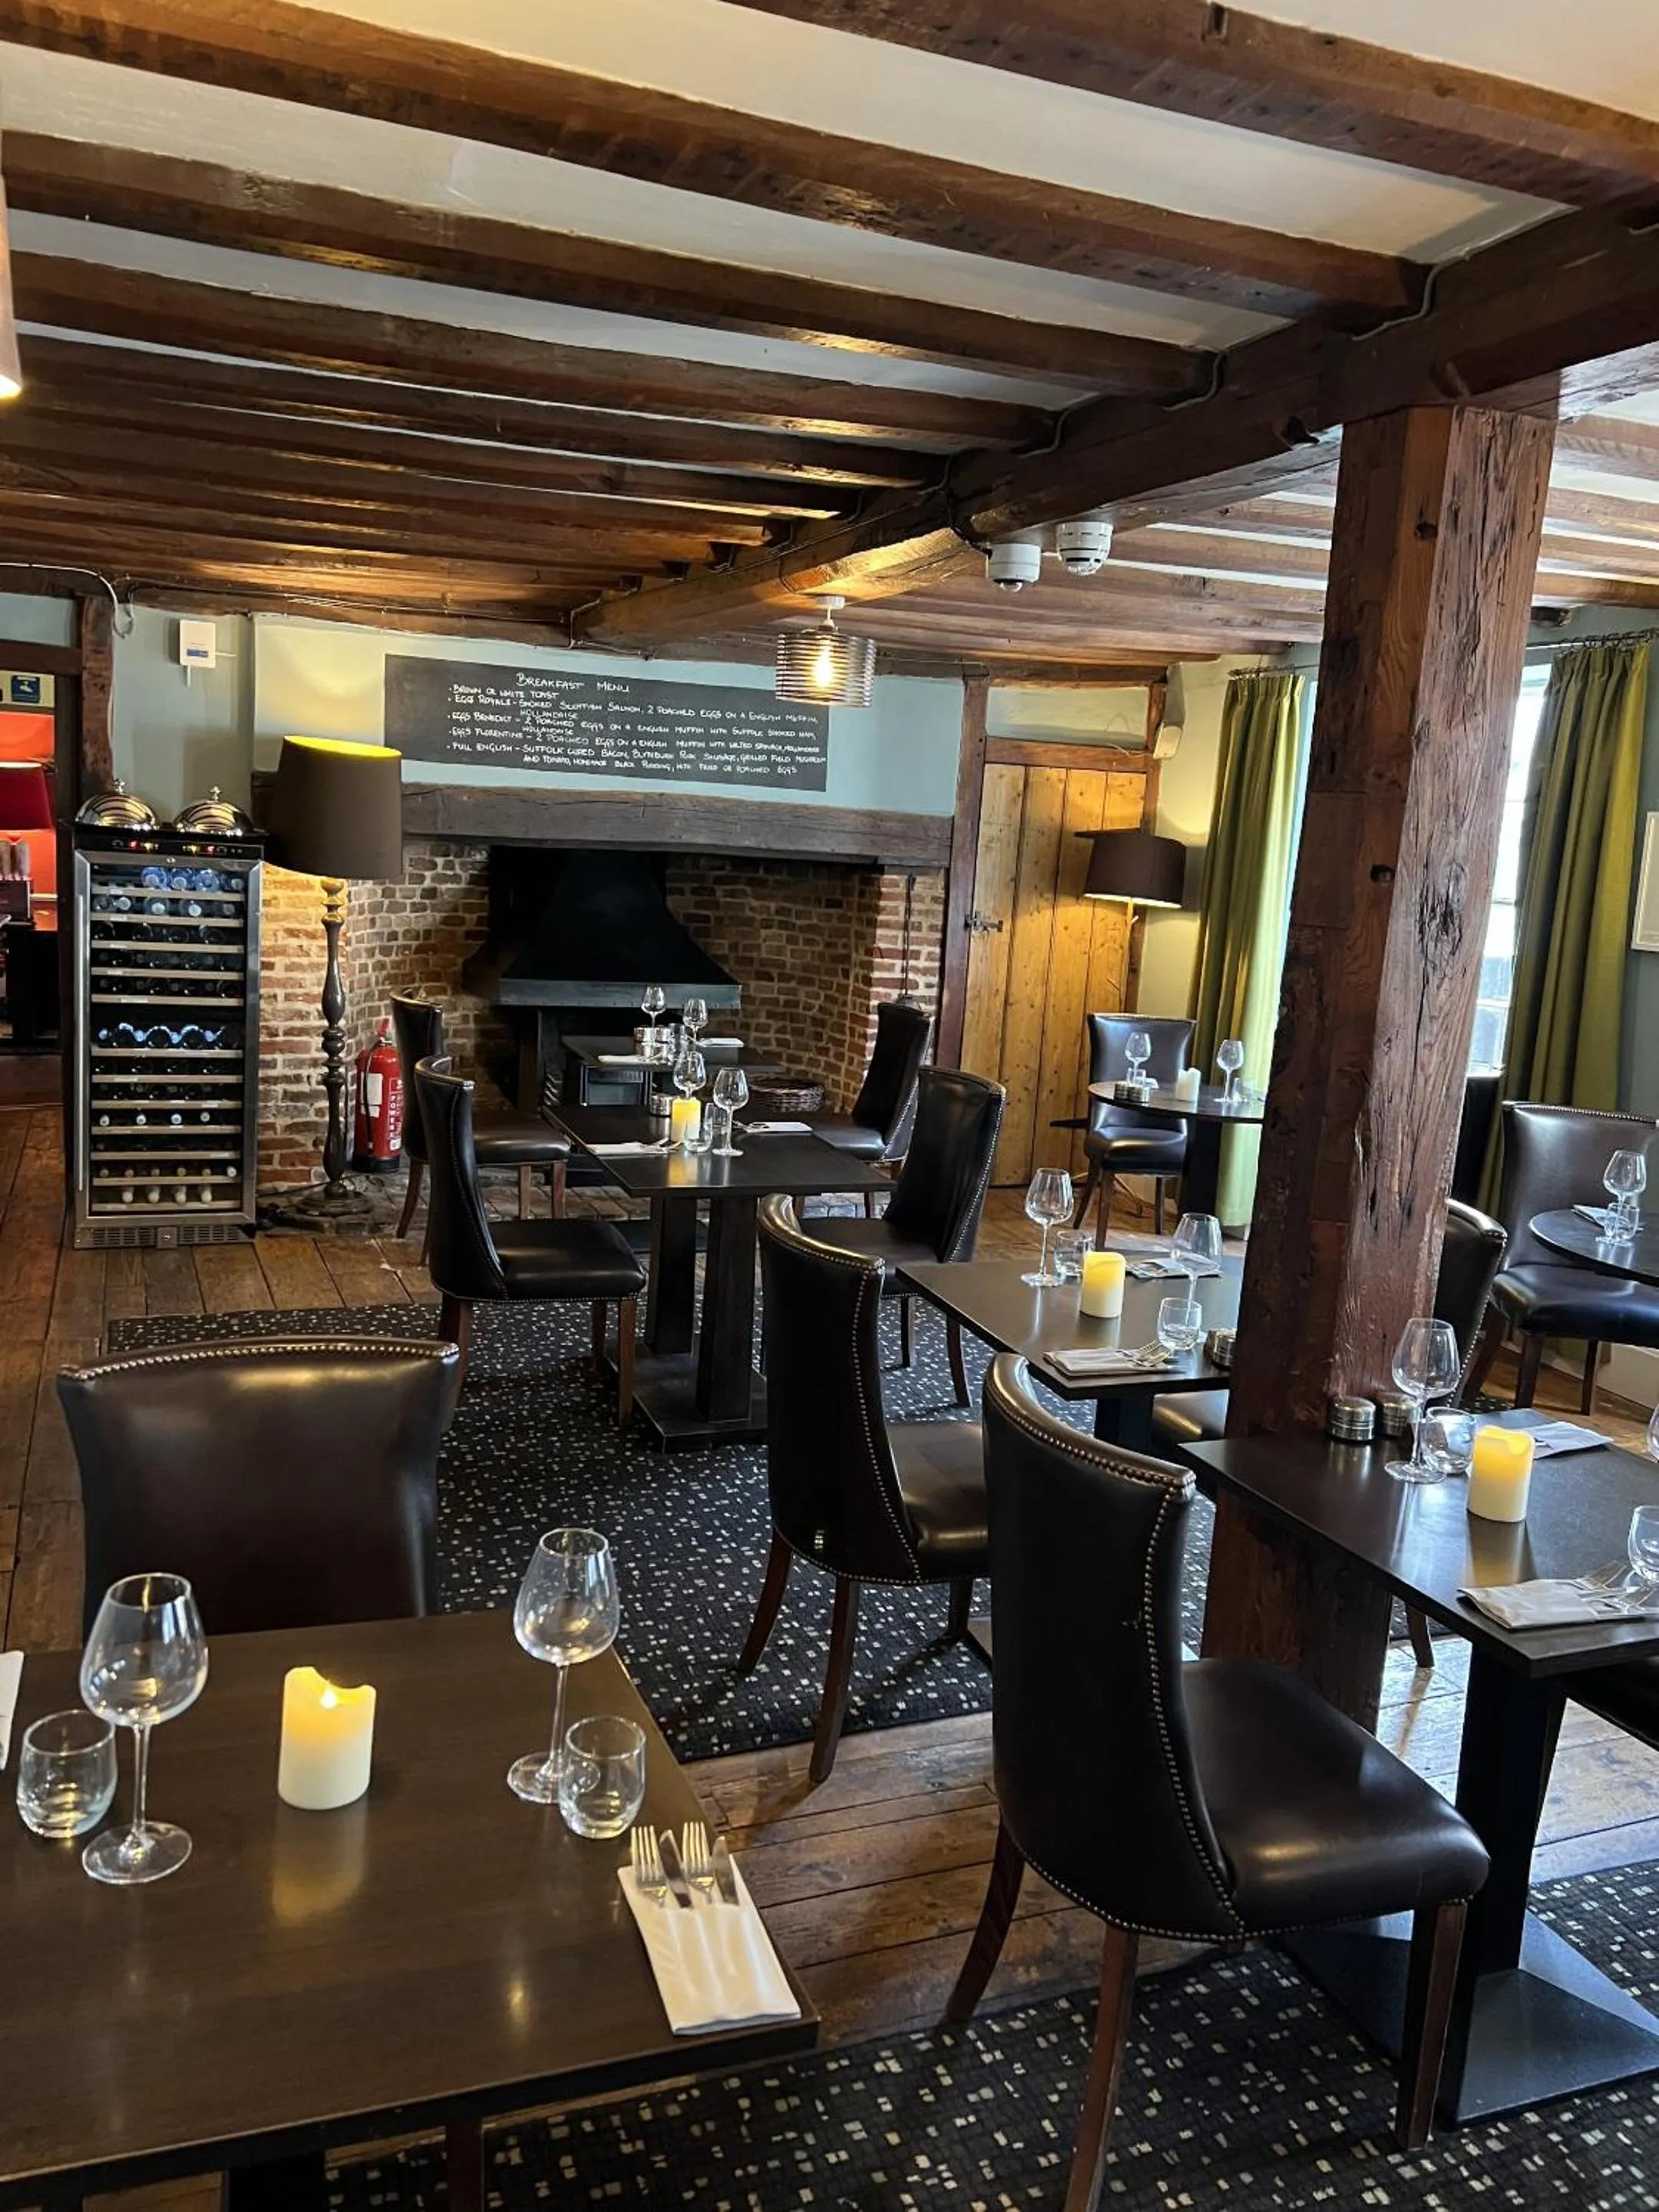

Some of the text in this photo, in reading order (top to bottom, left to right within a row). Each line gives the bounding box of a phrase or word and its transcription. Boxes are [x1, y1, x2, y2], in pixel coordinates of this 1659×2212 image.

[516, 673, 630, 693] BREAKFAST MENU
[453, 684, 481, 694] BROWN
[500, 689, 525, 698] WHITE
[530, 691, 560, 700] TOAST
[478, 694, 511, 706] ROYALE
[519, 699, 552, 708] SMOKED
[559, 700, 602, 710] SCOTTISH
[656, 706, 696, 716] POACHED
[451, 741, 473, 752] FULL
[475, 742, 514, 754] ENGLISH
[522, 743, 565, 754] SUFFOLK
[616, 738, 629, 746] ON
